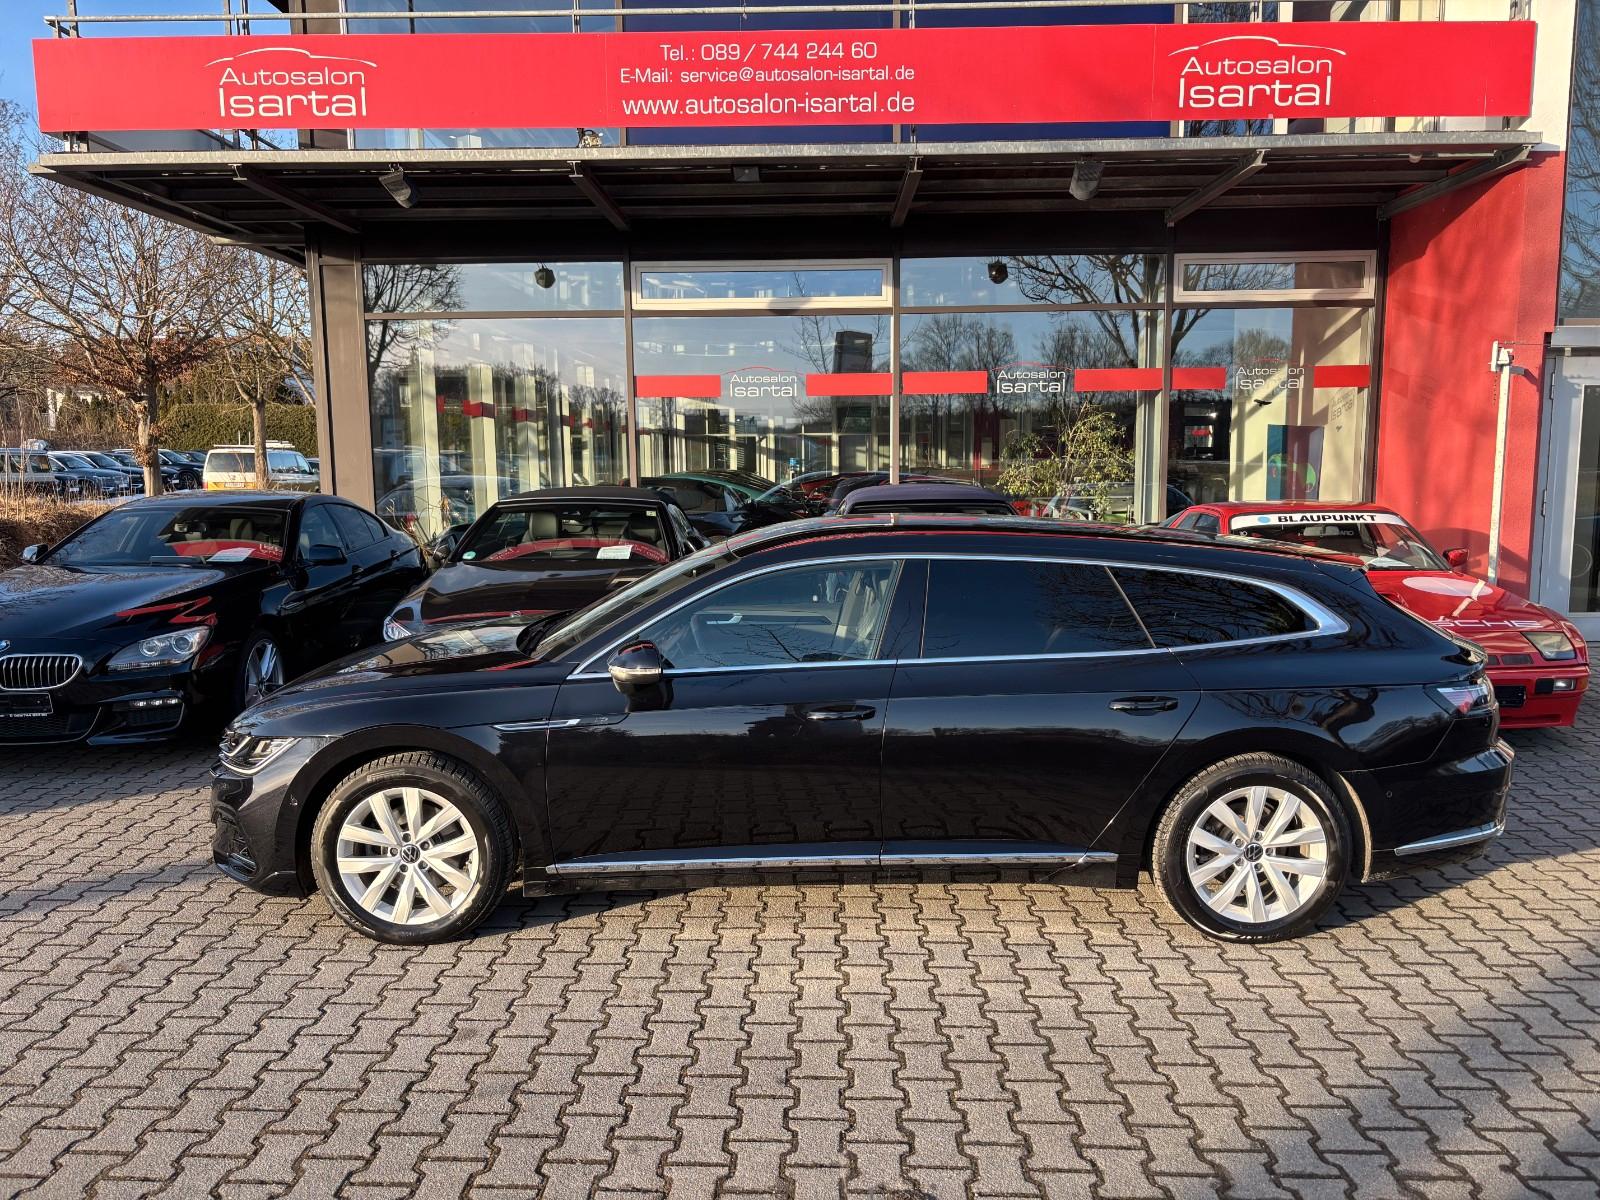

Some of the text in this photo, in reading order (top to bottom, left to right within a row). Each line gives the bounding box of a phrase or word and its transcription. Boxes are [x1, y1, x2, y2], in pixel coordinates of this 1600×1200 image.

[659, 41, 878, 63] Tel.: 089 / 744 244 60
[620, 65, 915, 83] E-Mail: service@autosalon-isartal.de
[1181, 55, 1332, 76] Autosalon
[219, 66, 365, 86] Autosalon
[1178, 75, 1332, 108] Isartal
[218, 86, 367, 117] Isartal
[622, 91, 915, 115] www.autosalon-isartal.de
[730, 373, 798, 383] Autosalon
[997, 369, 1066, 380] Autosalon
[729, 382, 798, 398] Isartal
[996, 378, 1066, 394] Isartal
[1277, 514, 1377, 523] BLAUPUNKT
